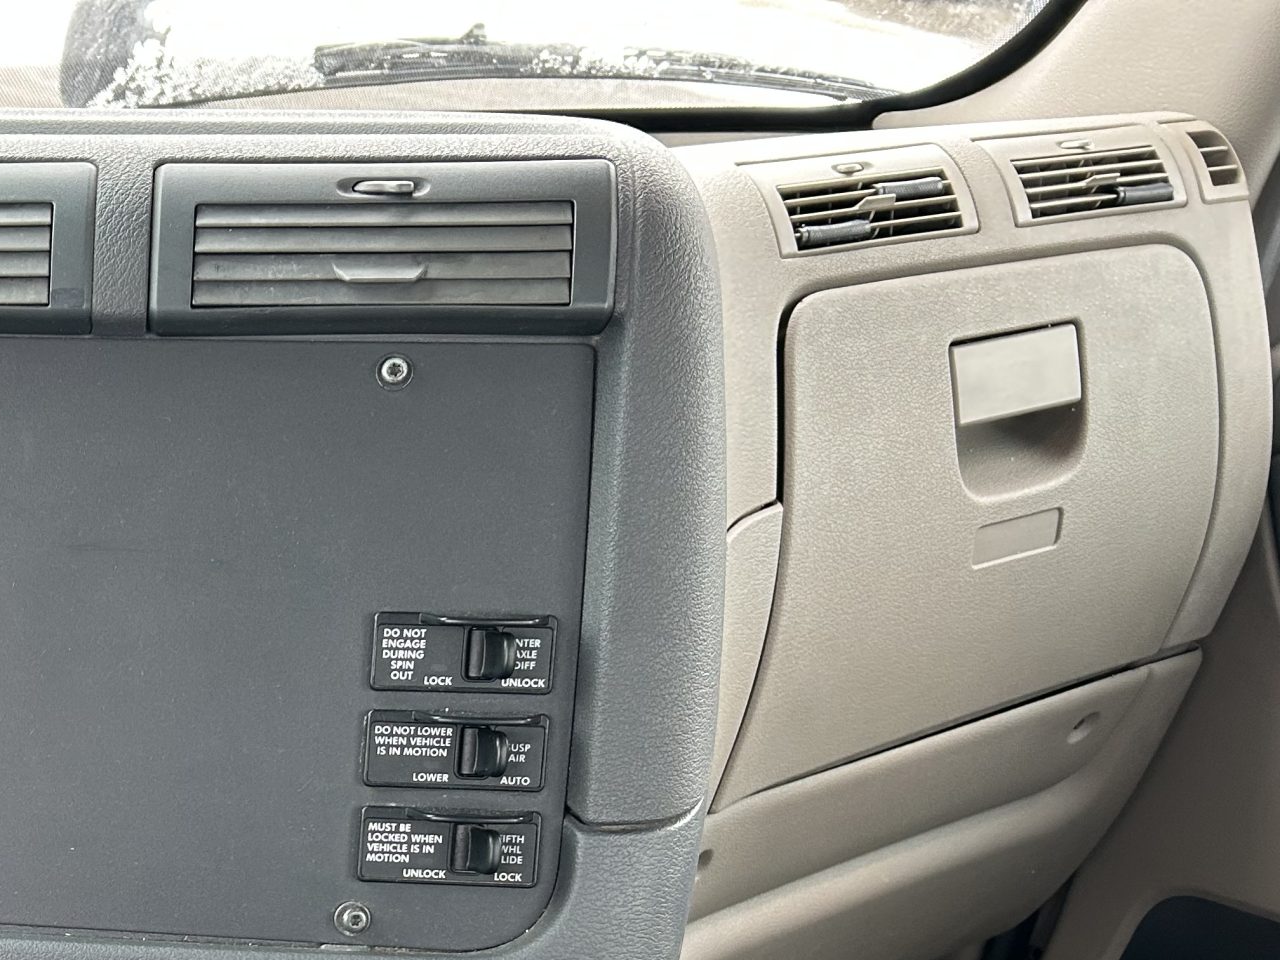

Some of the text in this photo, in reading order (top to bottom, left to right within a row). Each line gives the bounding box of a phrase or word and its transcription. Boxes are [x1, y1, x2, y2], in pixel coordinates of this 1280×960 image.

[383, 628, 427, 638] DO NOT
[382, 639, 426, 649] ENGAGE
[515, 638, 541, 648] NTER
[382, 649, 425, 660] DURING
[390, 660, 415, 670] SPIN
[390, 671, 414, 680] OUT
[423, 675, 453, 686] LOCK
[501, 677, 546, 688] UNLOCK
[374, 725, 453, 737] DO NOT LOWER
[374, 735, 452, 747] WHEN VEHICLE
[376, 746, 448, 757] IS IN MOTION
[509, 743, 531, 752] USP
[508, 753, 526, 763] AIR
[412, 772, 449, 783] LOWER
[500, 775, 531, 786] AUTO
[367, 822, 412, 832] MUST BE
[367, 832, 443, 844] LOCKED WHEN
[500, 834, 525, 844] IFTH
[366, 842, 435, 854] VEHICLE IS IN
[365, 852, 410, 863] MOTION
[500, 855, 523, 865] LIDE
[402, 868, 447, 879] UNLOCK
[493, 872, 522, 882] LOCK
